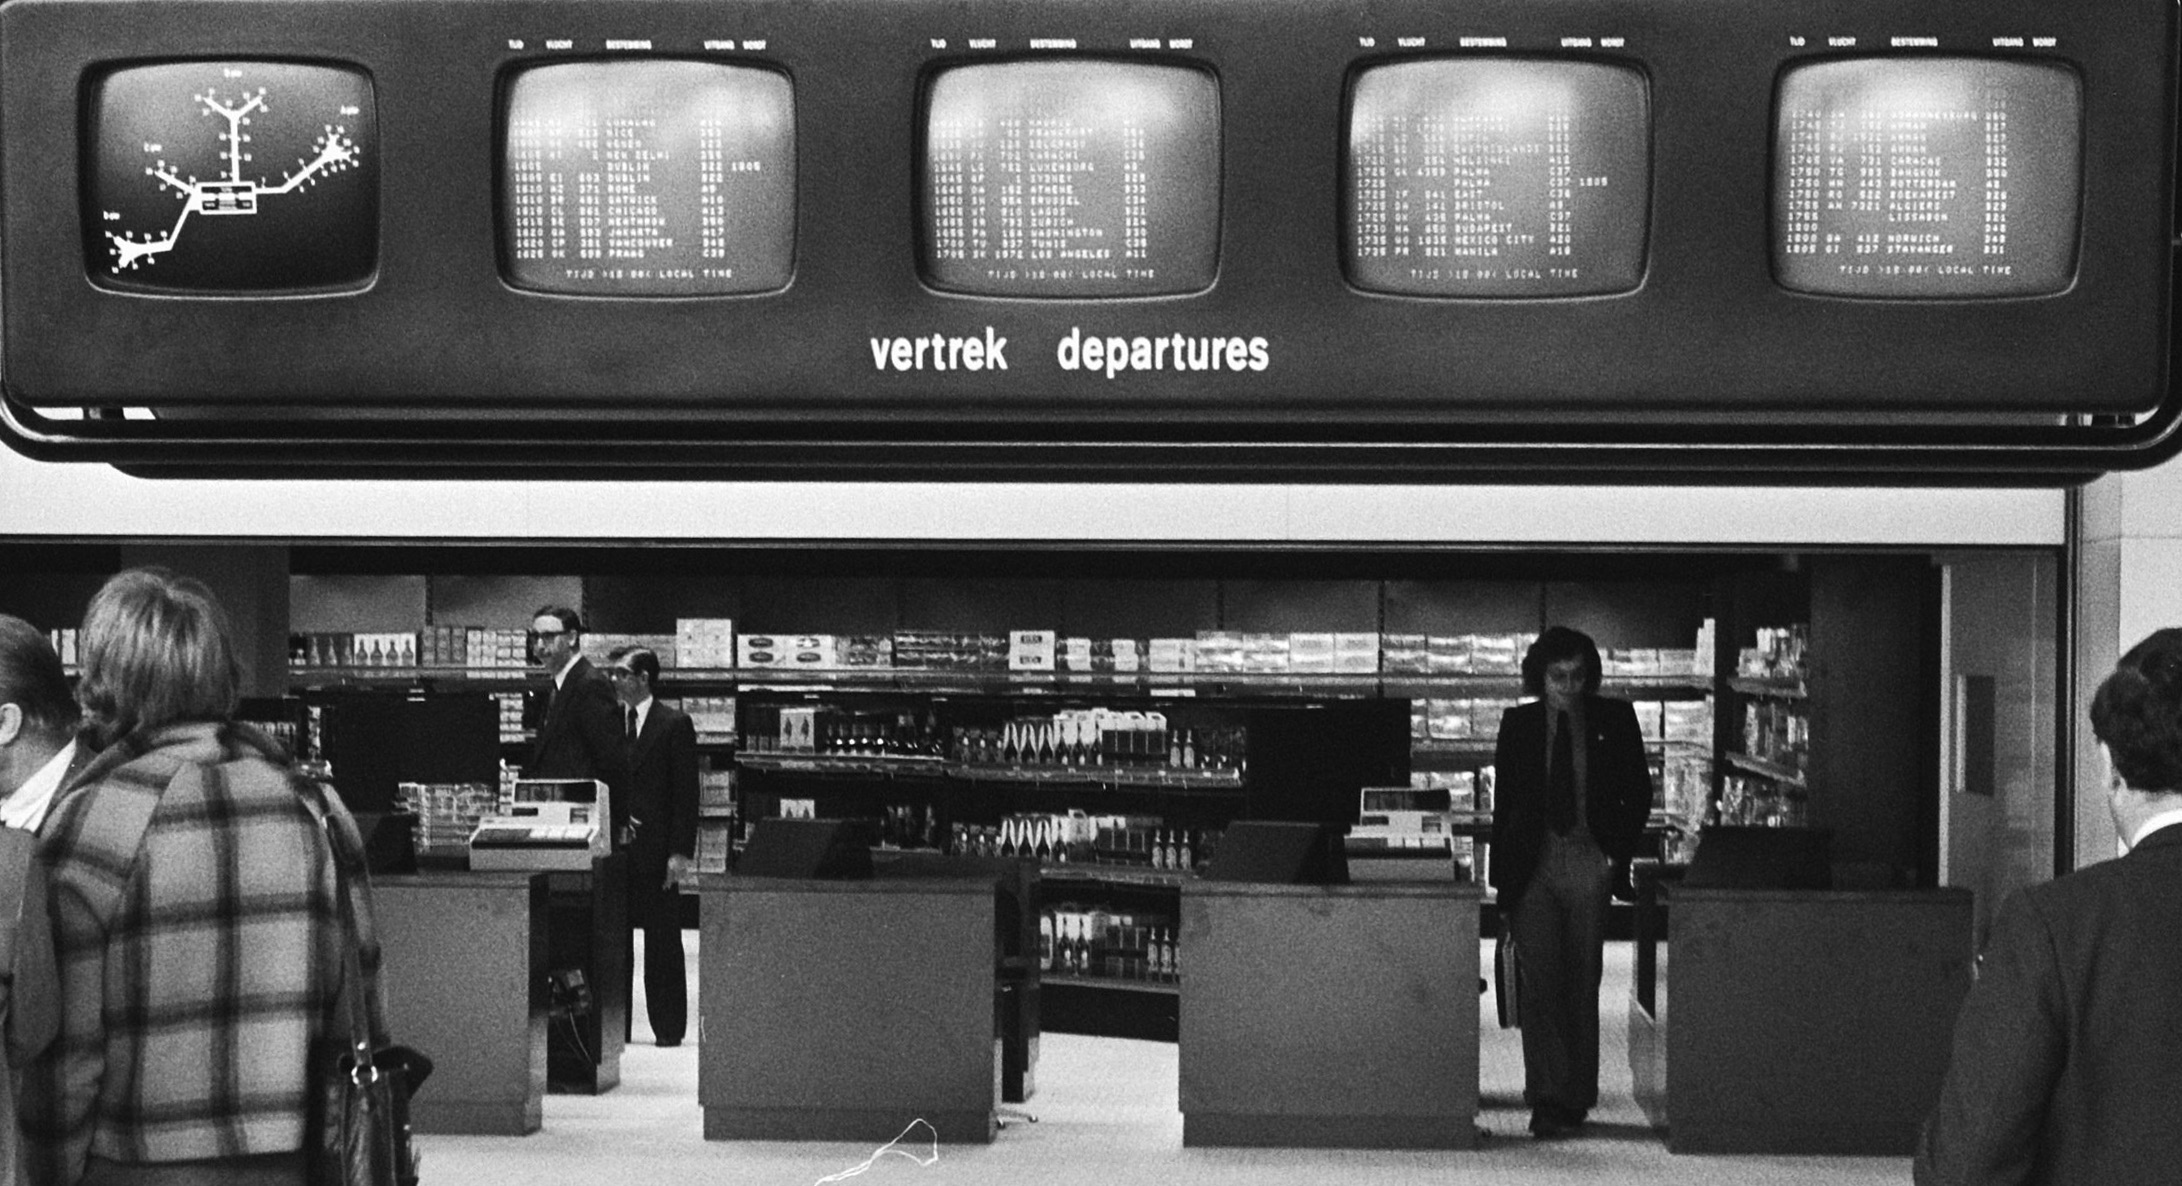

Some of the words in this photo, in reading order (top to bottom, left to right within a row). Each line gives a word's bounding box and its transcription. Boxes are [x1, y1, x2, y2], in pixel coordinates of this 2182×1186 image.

[606, 151, 627, 159] NEW
[635, 151, 670, 160] DELHI
[1891, 157, 1941, 165] CARACAS
[607, 163, 650, 171] DUBLIN
[608, 174, 650, 182] DUBLIN
[1030, 174, 1072, 183] SYDNEY
[1890, 179, 1956, 188] ROTTERDAM
[608, 185, 635, 193] ROME
[608, 196, 657, 204] GATWICK
[1455, 201, 1505, 210] BRISTOL
[1889, 202, 1940, 210] ALGIERS
[608, 207, 657, 215] CHICAGO
[1030, 208, 1065, 216] LAGOS
[1889, 213, 1948, 221] LISSABON
[1031, 218, 1074, 226] ZURICH
[1455, 224, 1512, 233] BUDAPEST
[1031, 229, 1103, 237] WASHINGTON
[609, 239, 673, 247] VANCOUVER
[1455, 236, 1498, 244] MEXICO
[1506, 235, 1534, 244] CITY
[1032, 240, 1066, 248] TUNIS
[1888, 245, 1953, 253] STAVANGER
[1031, 250, 1052, 259] LOS
[1060, 250, 1110, 258] ANGELES
[660, 270, 694, 278] LOCAL
[703, 270, 732, 278] TIME
[1082, 270, 1116, 278] LOCAL
[1127, 270, 1154, 278] TIME
[1506, 269, 1541, 279] LOCAL
[1551, 269, 1577, 279] TIME
[1939, 266, 1973, 275] LOCAL
[1983, 266, 2011, 275] TIME
[870, 326, 1008, 371] vertrek
[1057, 326, 1270, 379] departures
